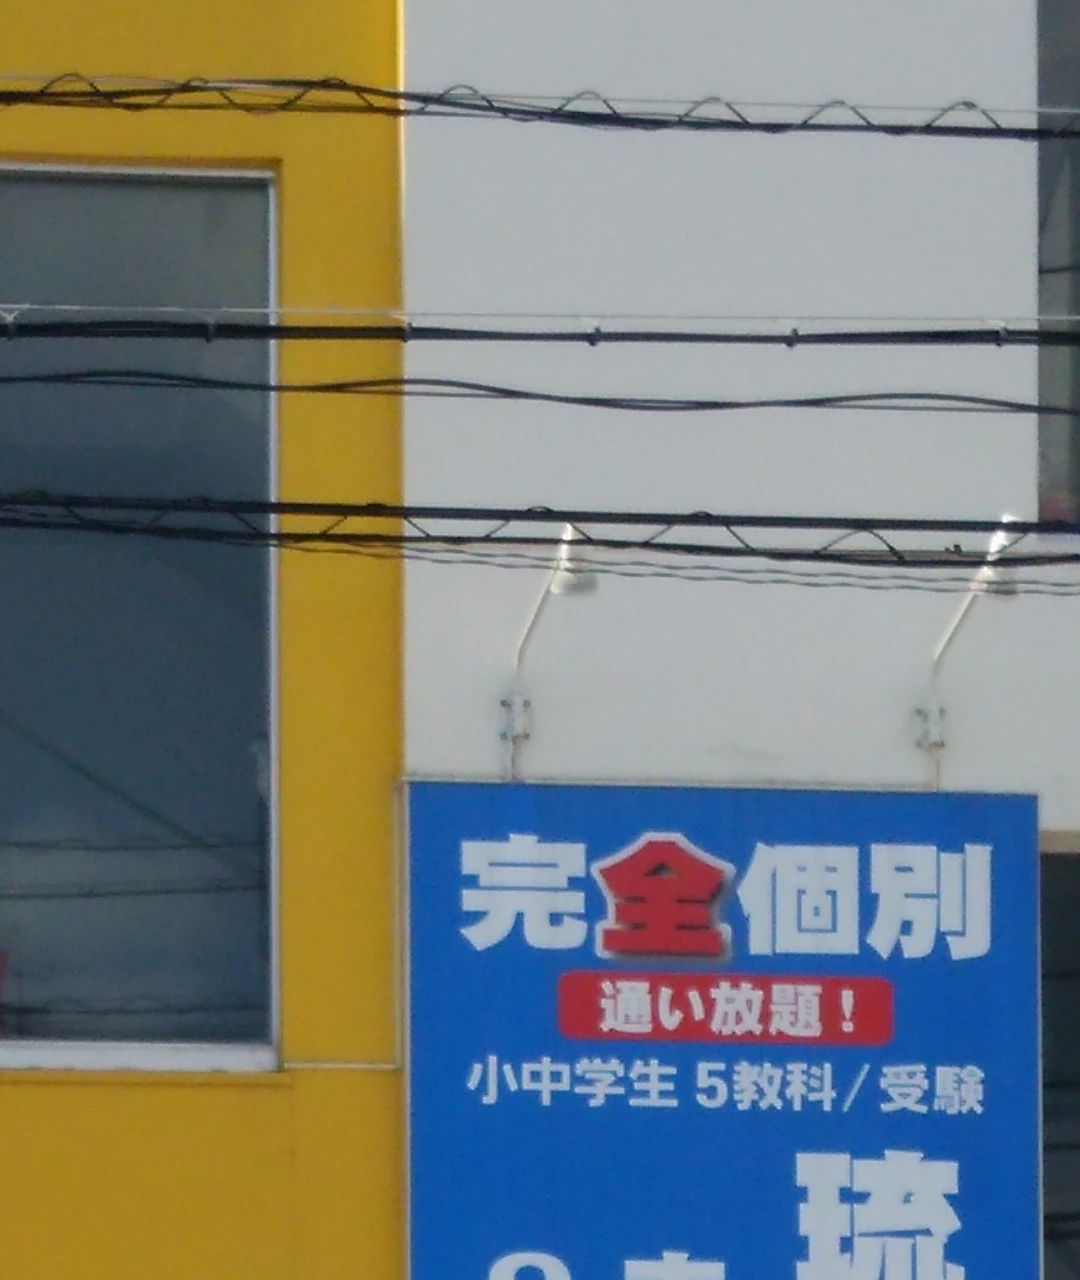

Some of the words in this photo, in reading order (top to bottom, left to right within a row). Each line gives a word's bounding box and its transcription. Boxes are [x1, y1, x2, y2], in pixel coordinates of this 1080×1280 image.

[460, 832, 993, 960] 完全個別
[600, 981, 854, 1037] 通い放題!
[467, 1055, 678, 1107] 小中学生
